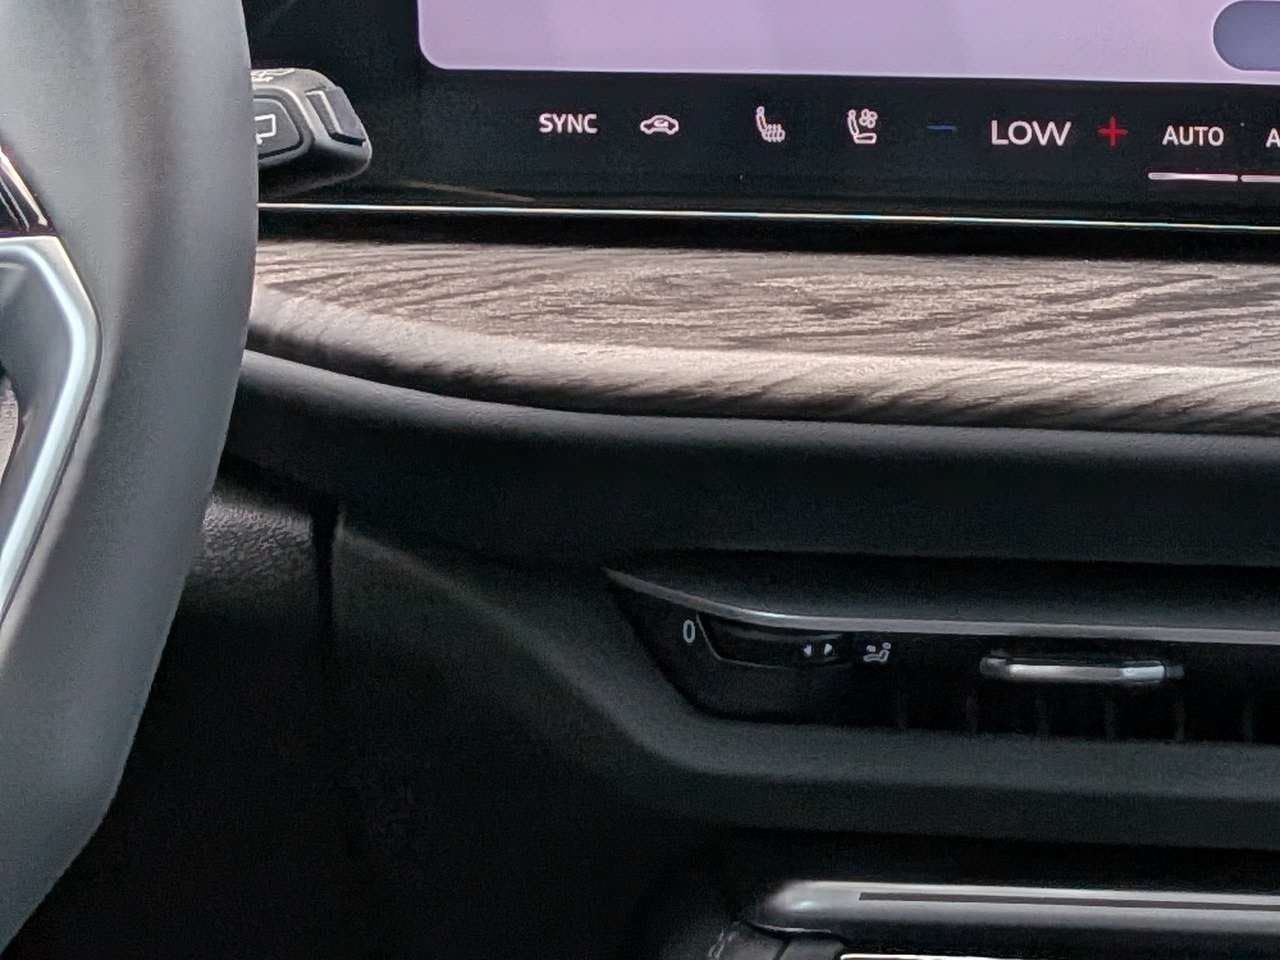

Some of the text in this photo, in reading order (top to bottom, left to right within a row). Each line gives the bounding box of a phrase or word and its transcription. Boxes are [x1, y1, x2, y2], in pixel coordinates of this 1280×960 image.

[538, 112, 599, 134] SYNC
[990, 119, 1072, 147] LOW
[1161, 124, 1225, 147] AUTO
[682, 618, 696, 644] 0
